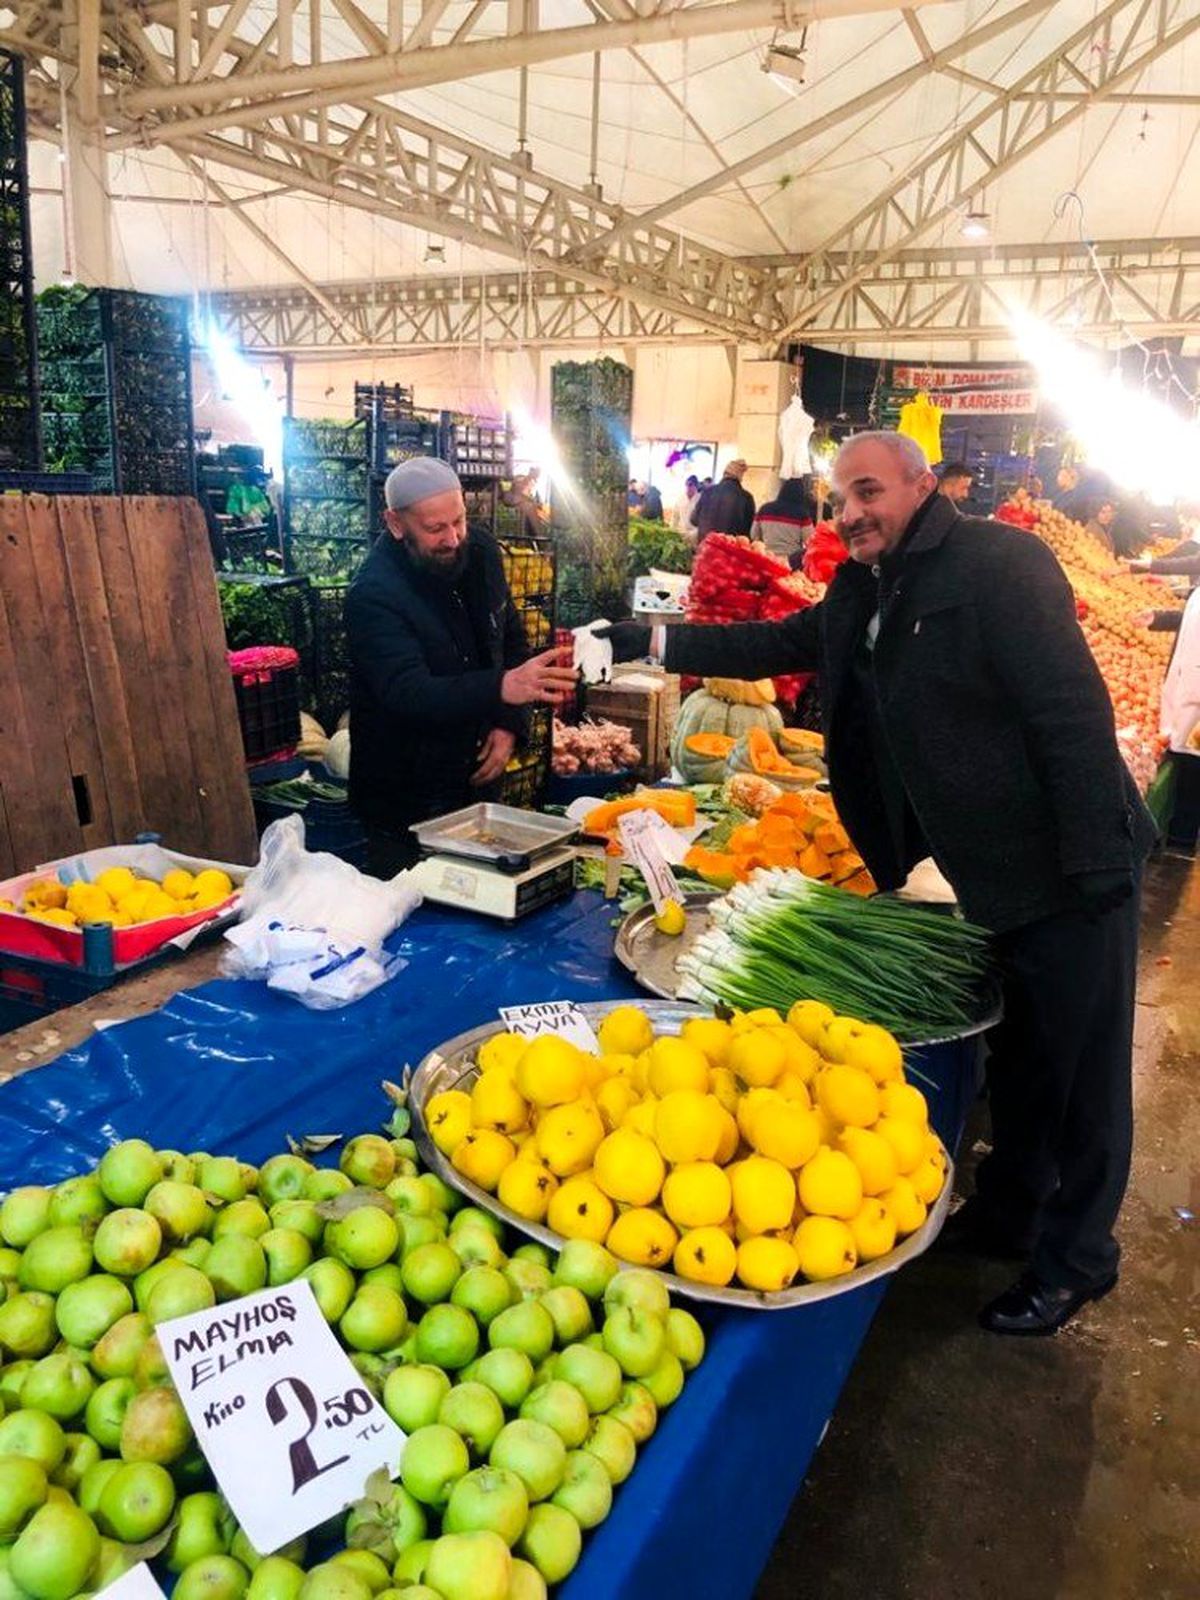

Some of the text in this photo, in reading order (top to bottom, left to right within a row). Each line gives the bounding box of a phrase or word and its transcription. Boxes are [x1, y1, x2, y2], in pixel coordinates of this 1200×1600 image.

[503, 1001, 581, 1021] EKMEK
[173, 1296, 297, 1361] MAYHOŞ
[190, 1330, 294, 1391] ELMA
[356, 1422, 385, 1441] TL
